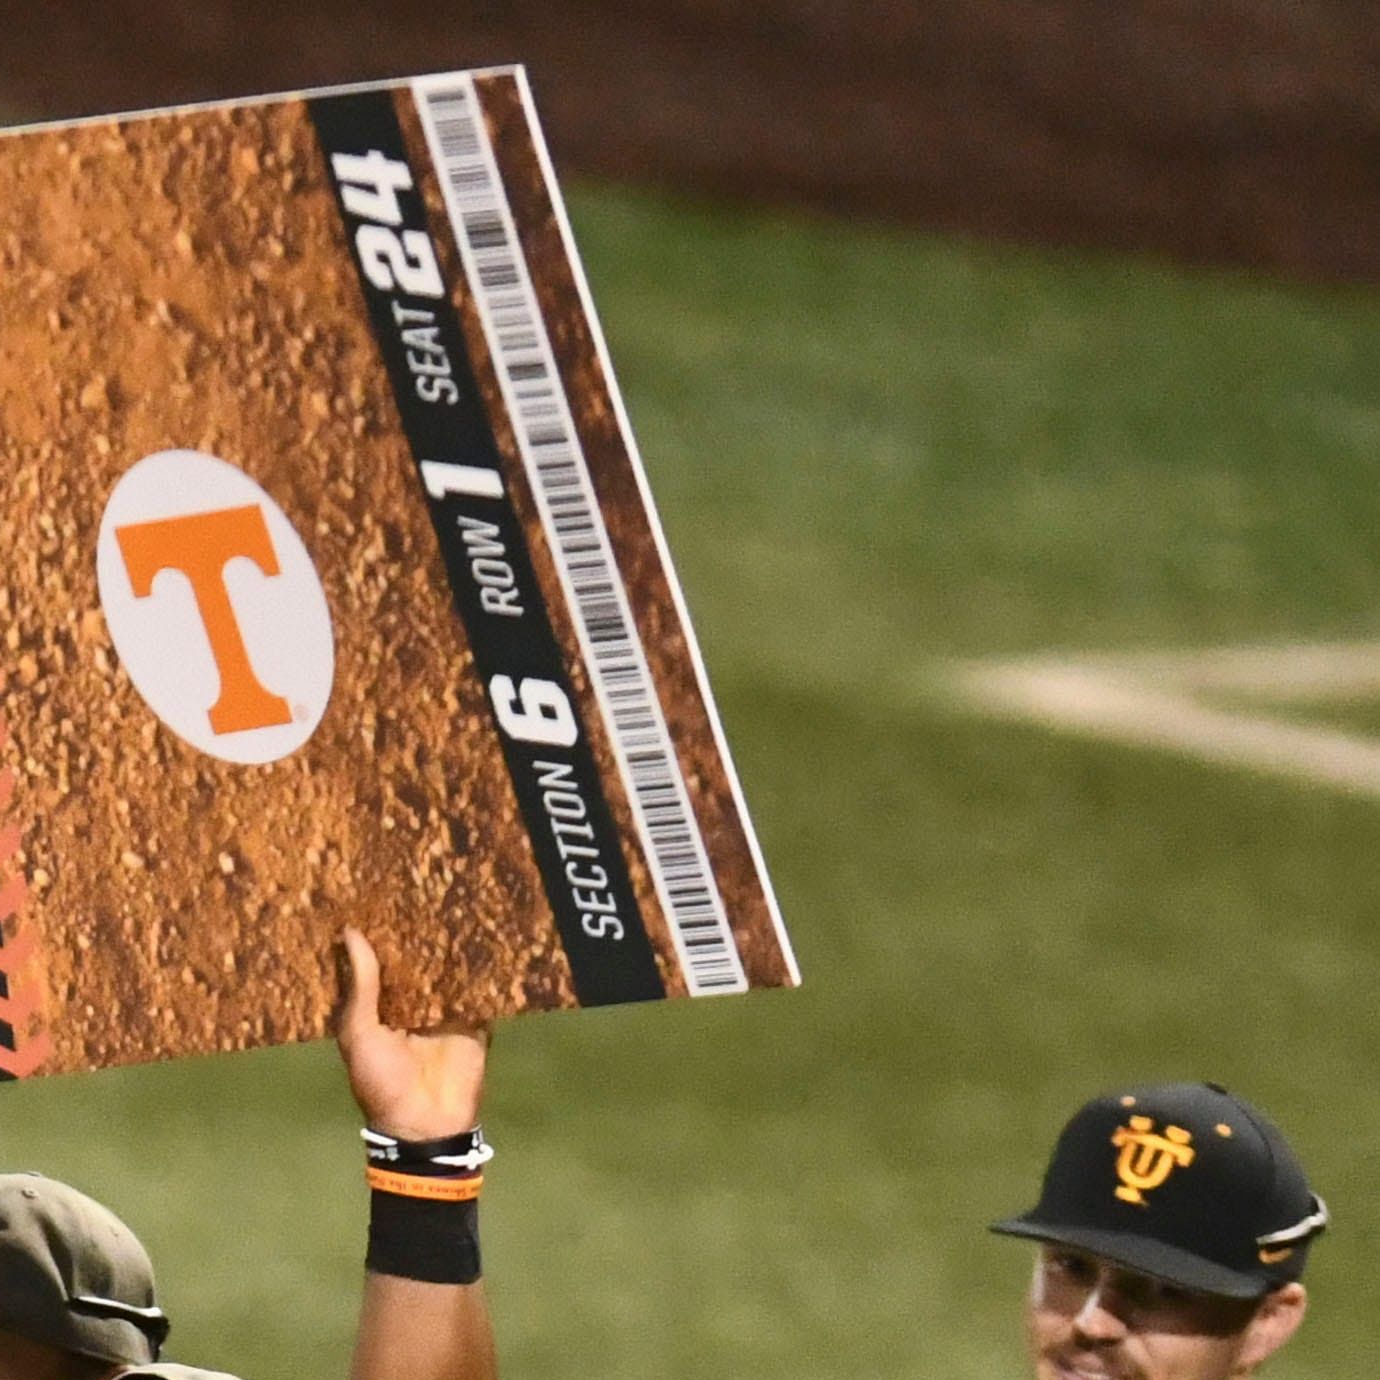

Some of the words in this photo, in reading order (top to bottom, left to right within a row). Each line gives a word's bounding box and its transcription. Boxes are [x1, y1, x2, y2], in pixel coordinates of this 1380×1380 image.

[331, 150, 445, 299] 24
[391, 301, 460, 406] SEAT
[420, 460, 505, 502] 1
[456, 515, 525, 617] ROW
[114, 503, 293, 736] T
[489, 674, 579, 748] 6
[532, 760, 625, 942] SECTION
